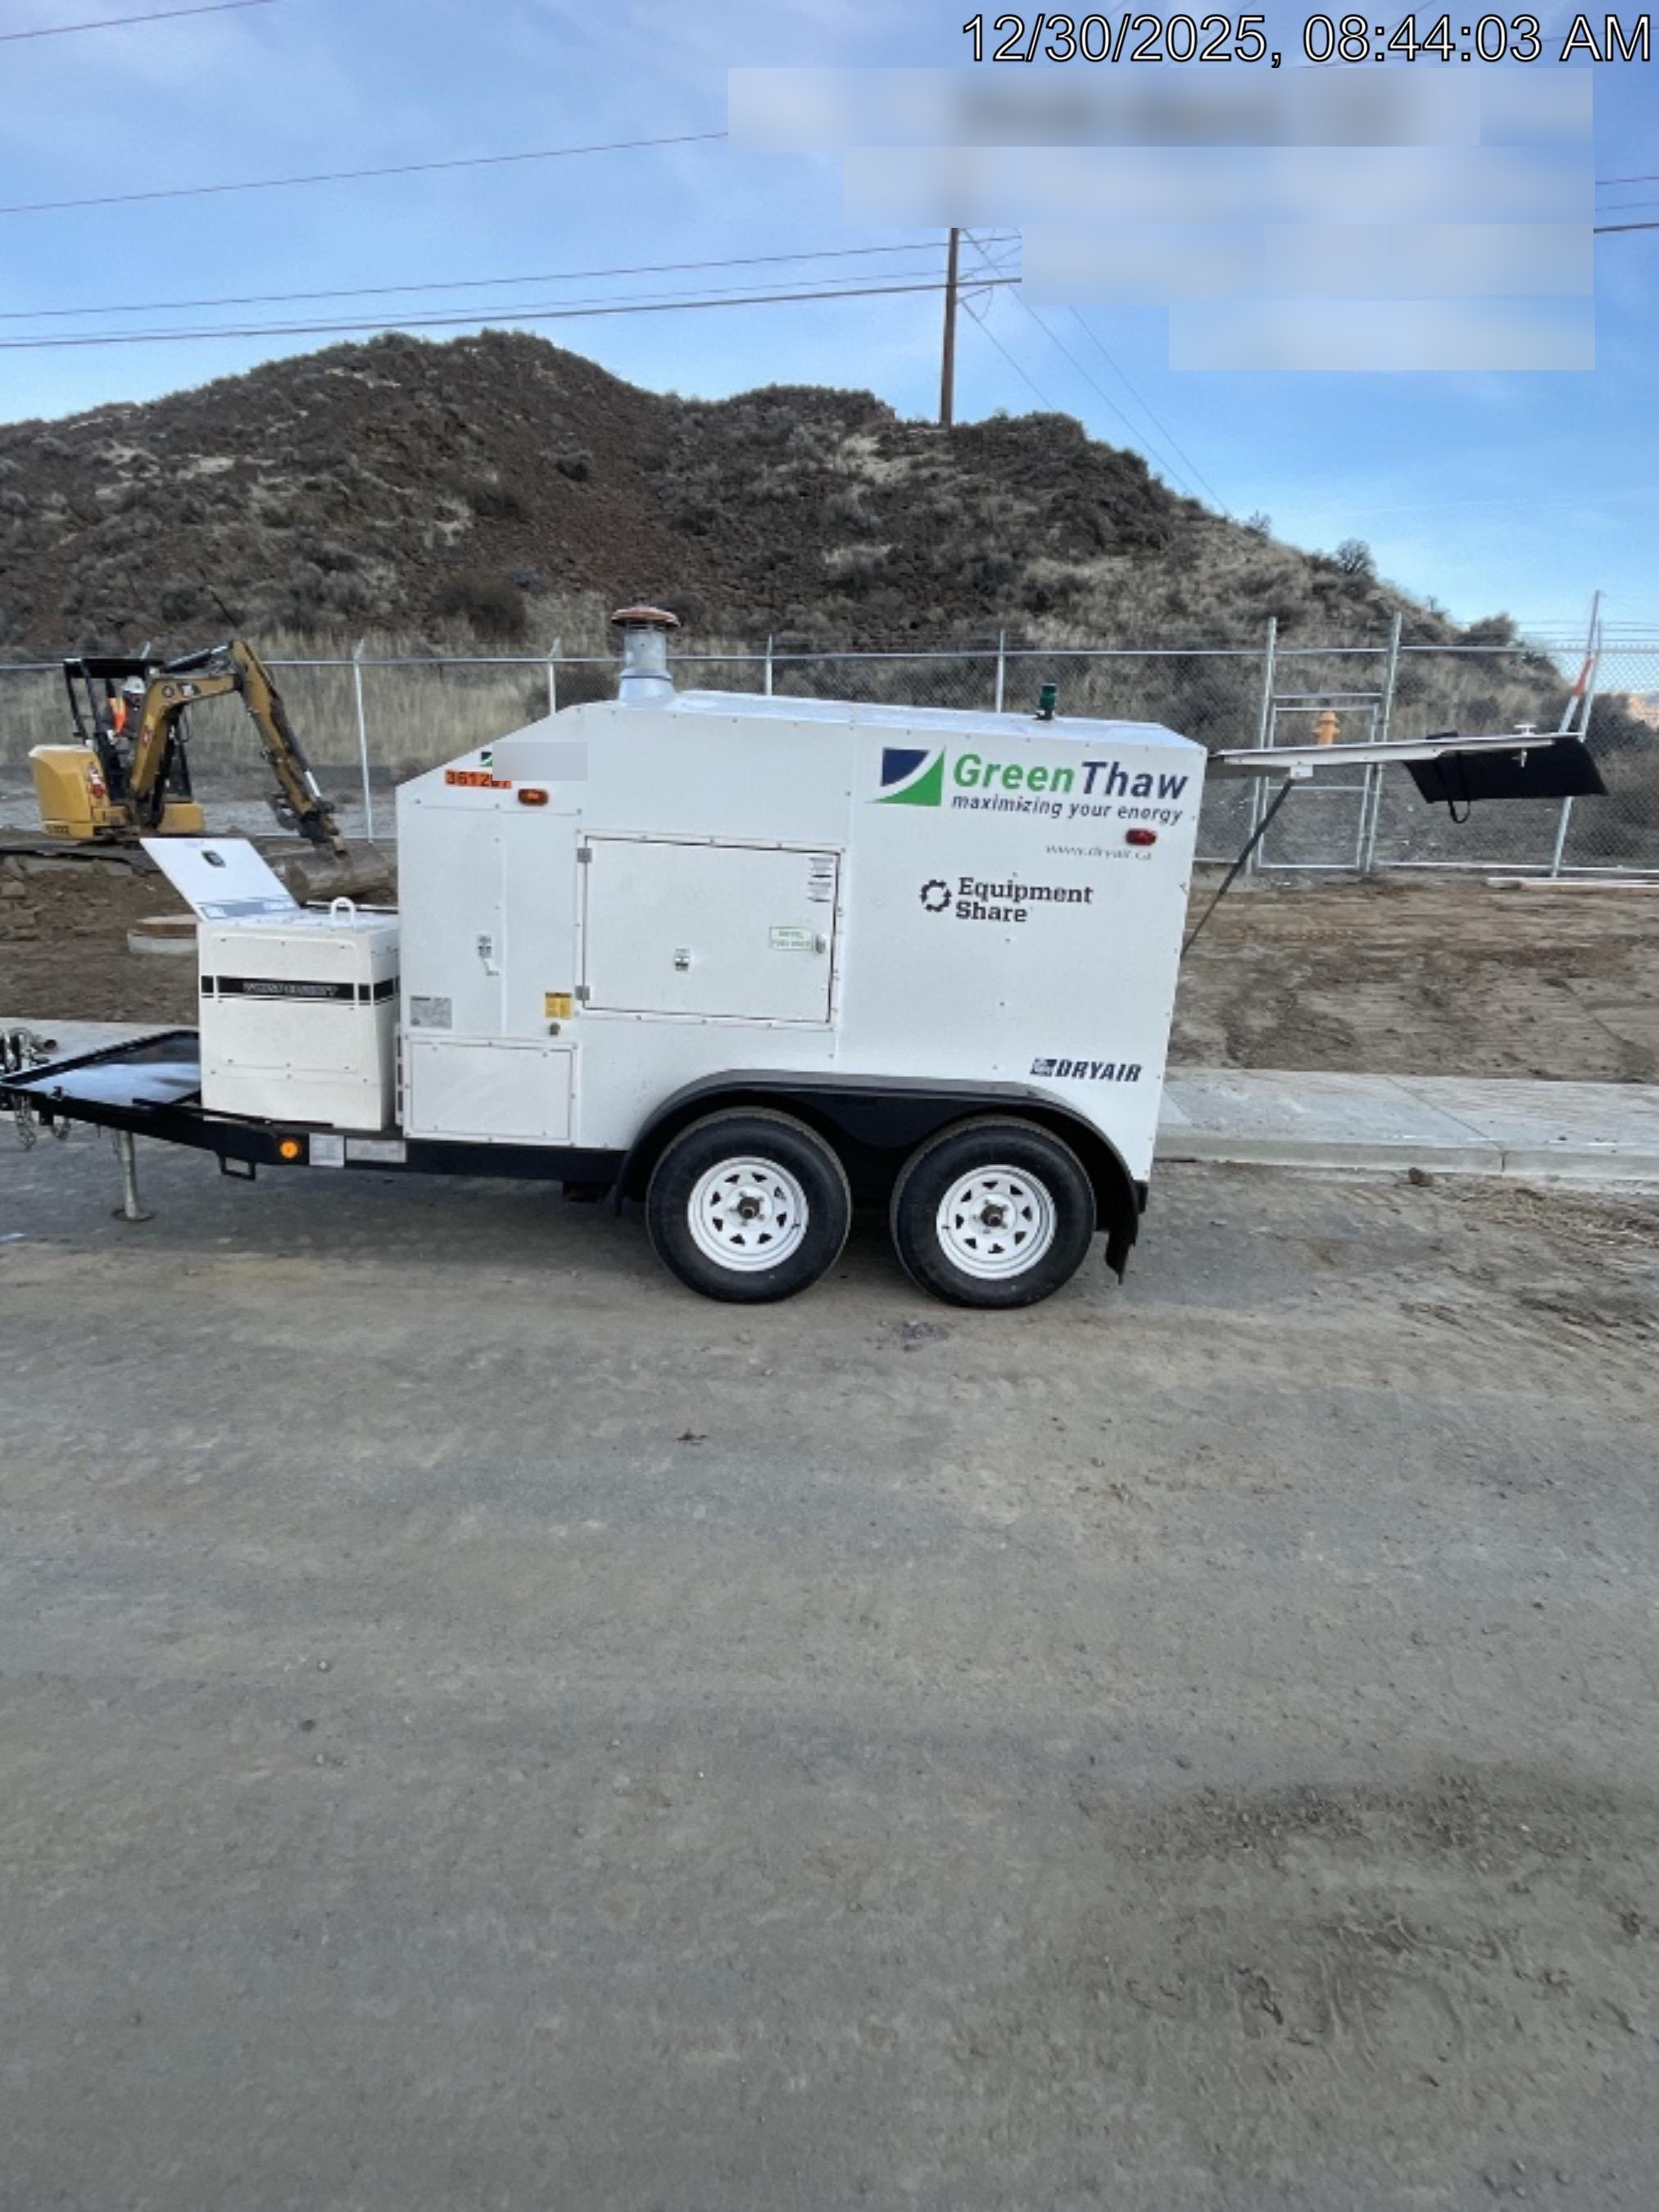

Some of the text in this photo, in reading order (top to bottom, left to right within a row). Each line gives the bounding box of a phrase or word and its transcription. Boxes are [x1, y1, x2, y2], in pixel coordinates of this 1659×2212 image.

[951, 793, 1183, 826] maximizing your energy
[958, 877, 1094, 904] Equipment
[955, 900, 1027, 922] Share
[1055, 1058, 1143, 1082] DRYAIR
